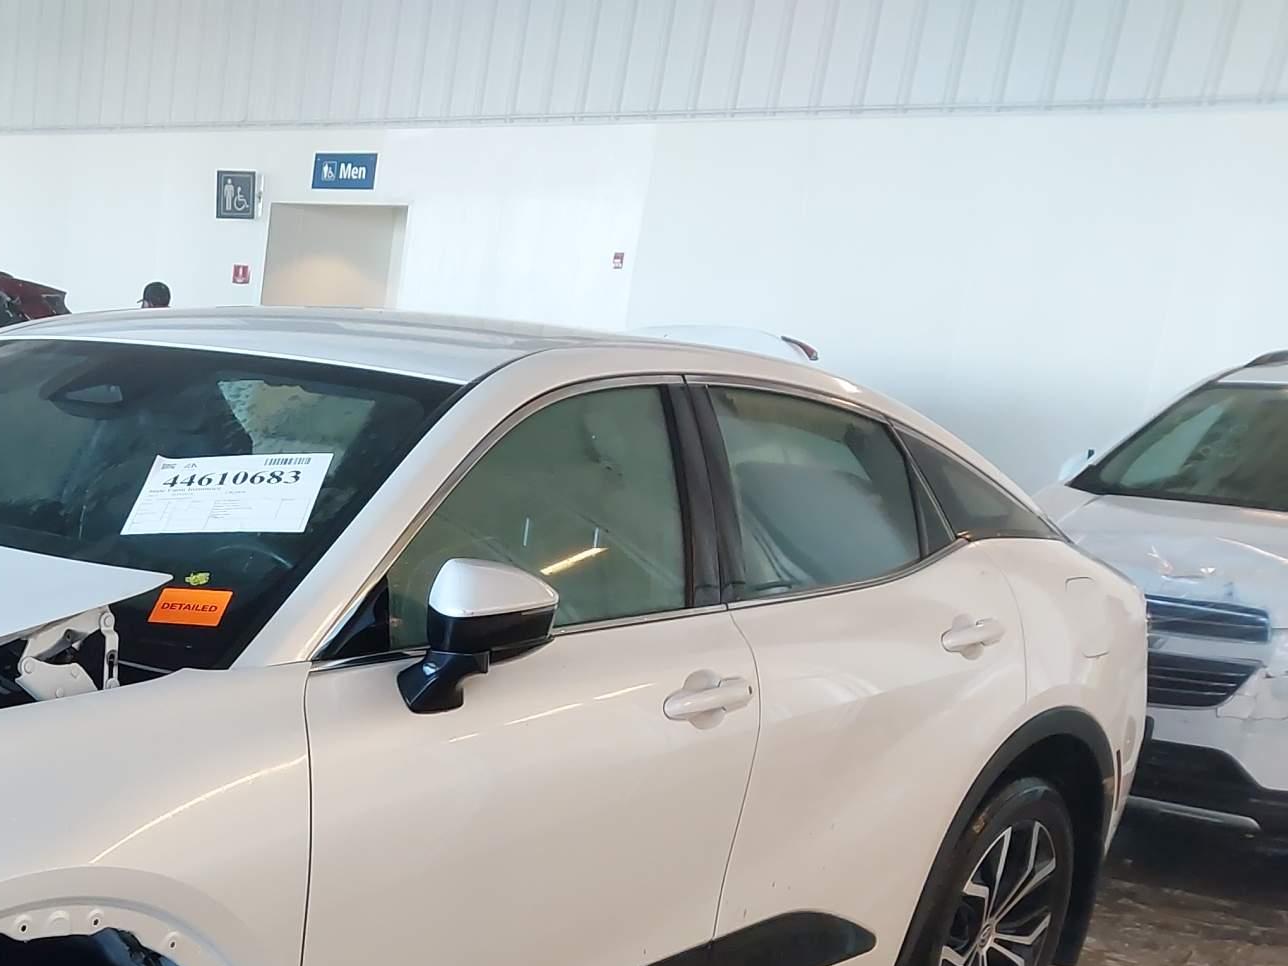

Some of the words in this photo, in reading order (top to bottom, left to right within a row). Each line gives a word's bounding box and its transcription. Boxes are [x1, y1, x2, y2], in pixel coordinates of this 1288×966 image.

[339, 163, 367, 180] Men
[162, 470, 302, 488] 44610683
[161, 602, 218, 613] DETAILED
